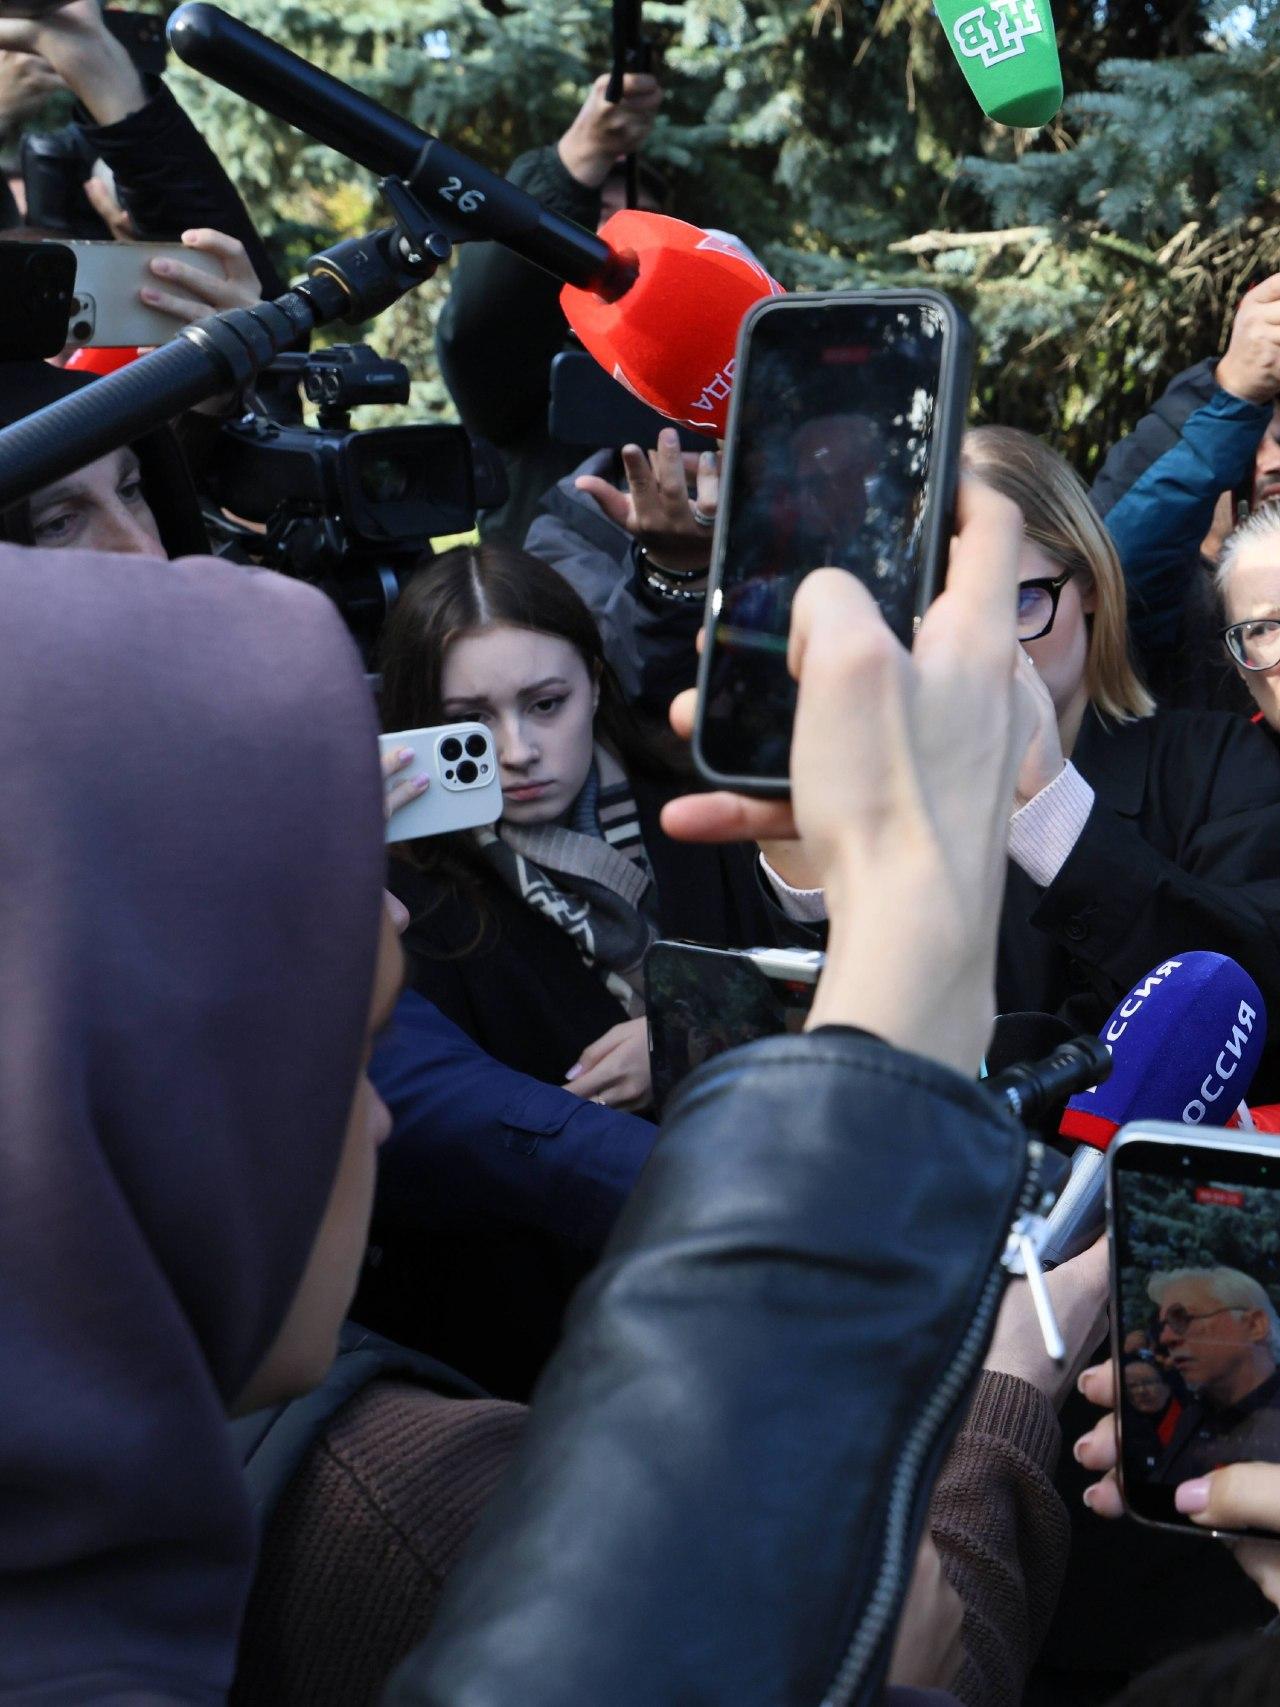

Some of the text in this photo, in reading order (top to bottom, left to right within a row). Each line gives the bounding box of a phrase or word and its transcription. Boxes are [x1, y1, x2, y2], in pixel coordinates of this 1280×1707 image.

[953, 0, 1042, 68] НТВ
[438, 176, 486, 212] 26
[1086, 960, 1182, 1094] ССИЯ
[1181, 999, 1257, 1127] ОССИЯ
